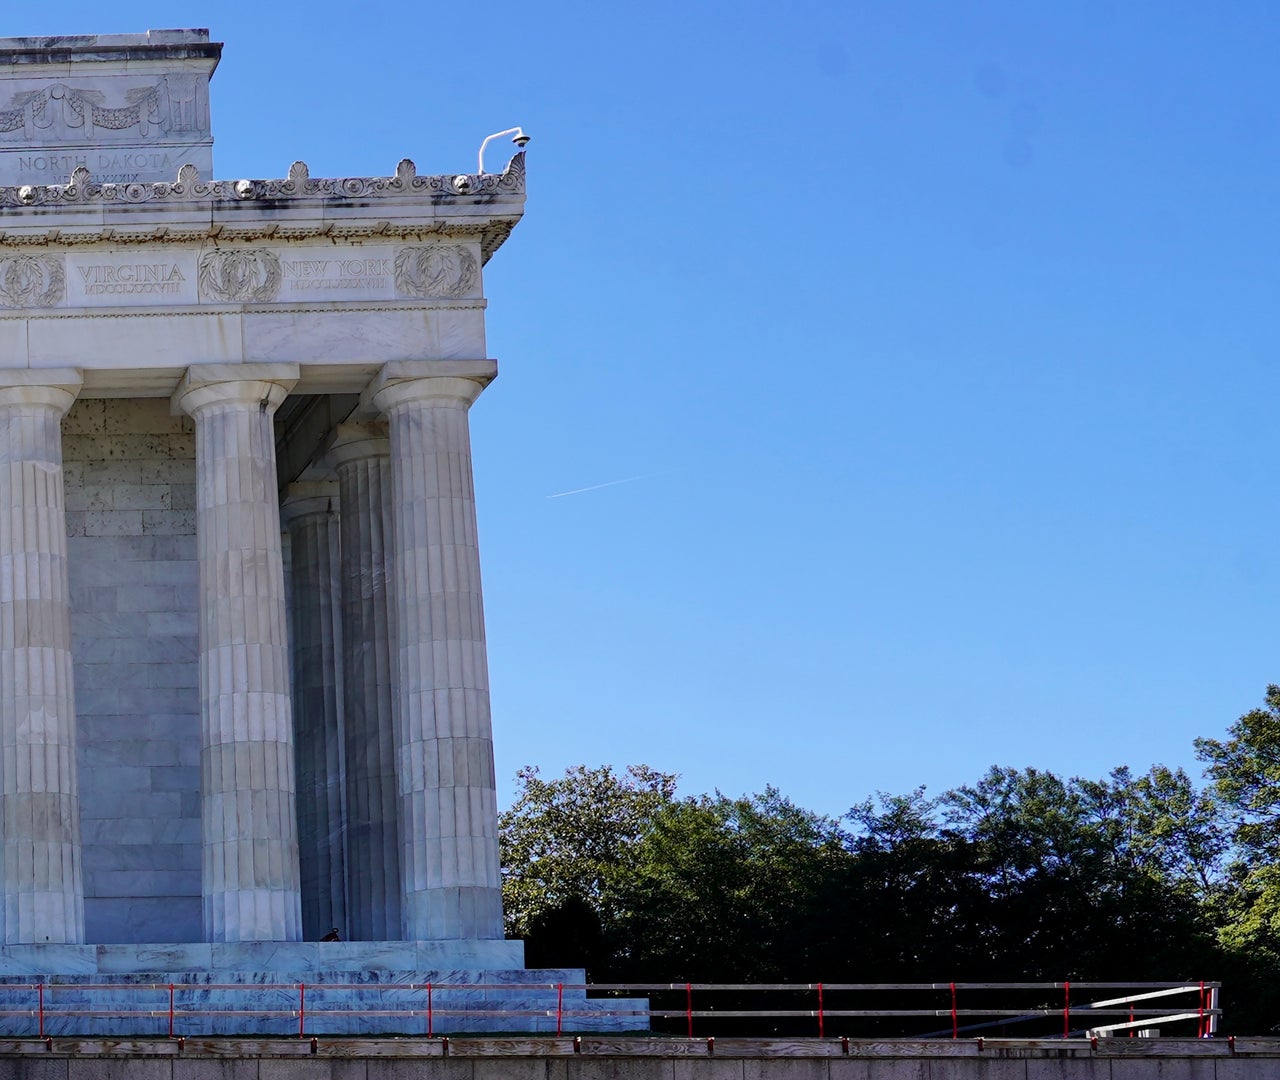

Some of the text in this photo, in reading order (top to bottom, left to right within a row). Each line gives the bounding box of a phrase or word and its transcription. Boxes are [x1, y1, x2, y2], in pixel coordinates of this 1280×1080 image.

[19, 153, 171, 171] NORTH DAKOTA
[77, 264, 186, 283] VIRGINIA
[281, 259, 391, 277] NEW YORK
